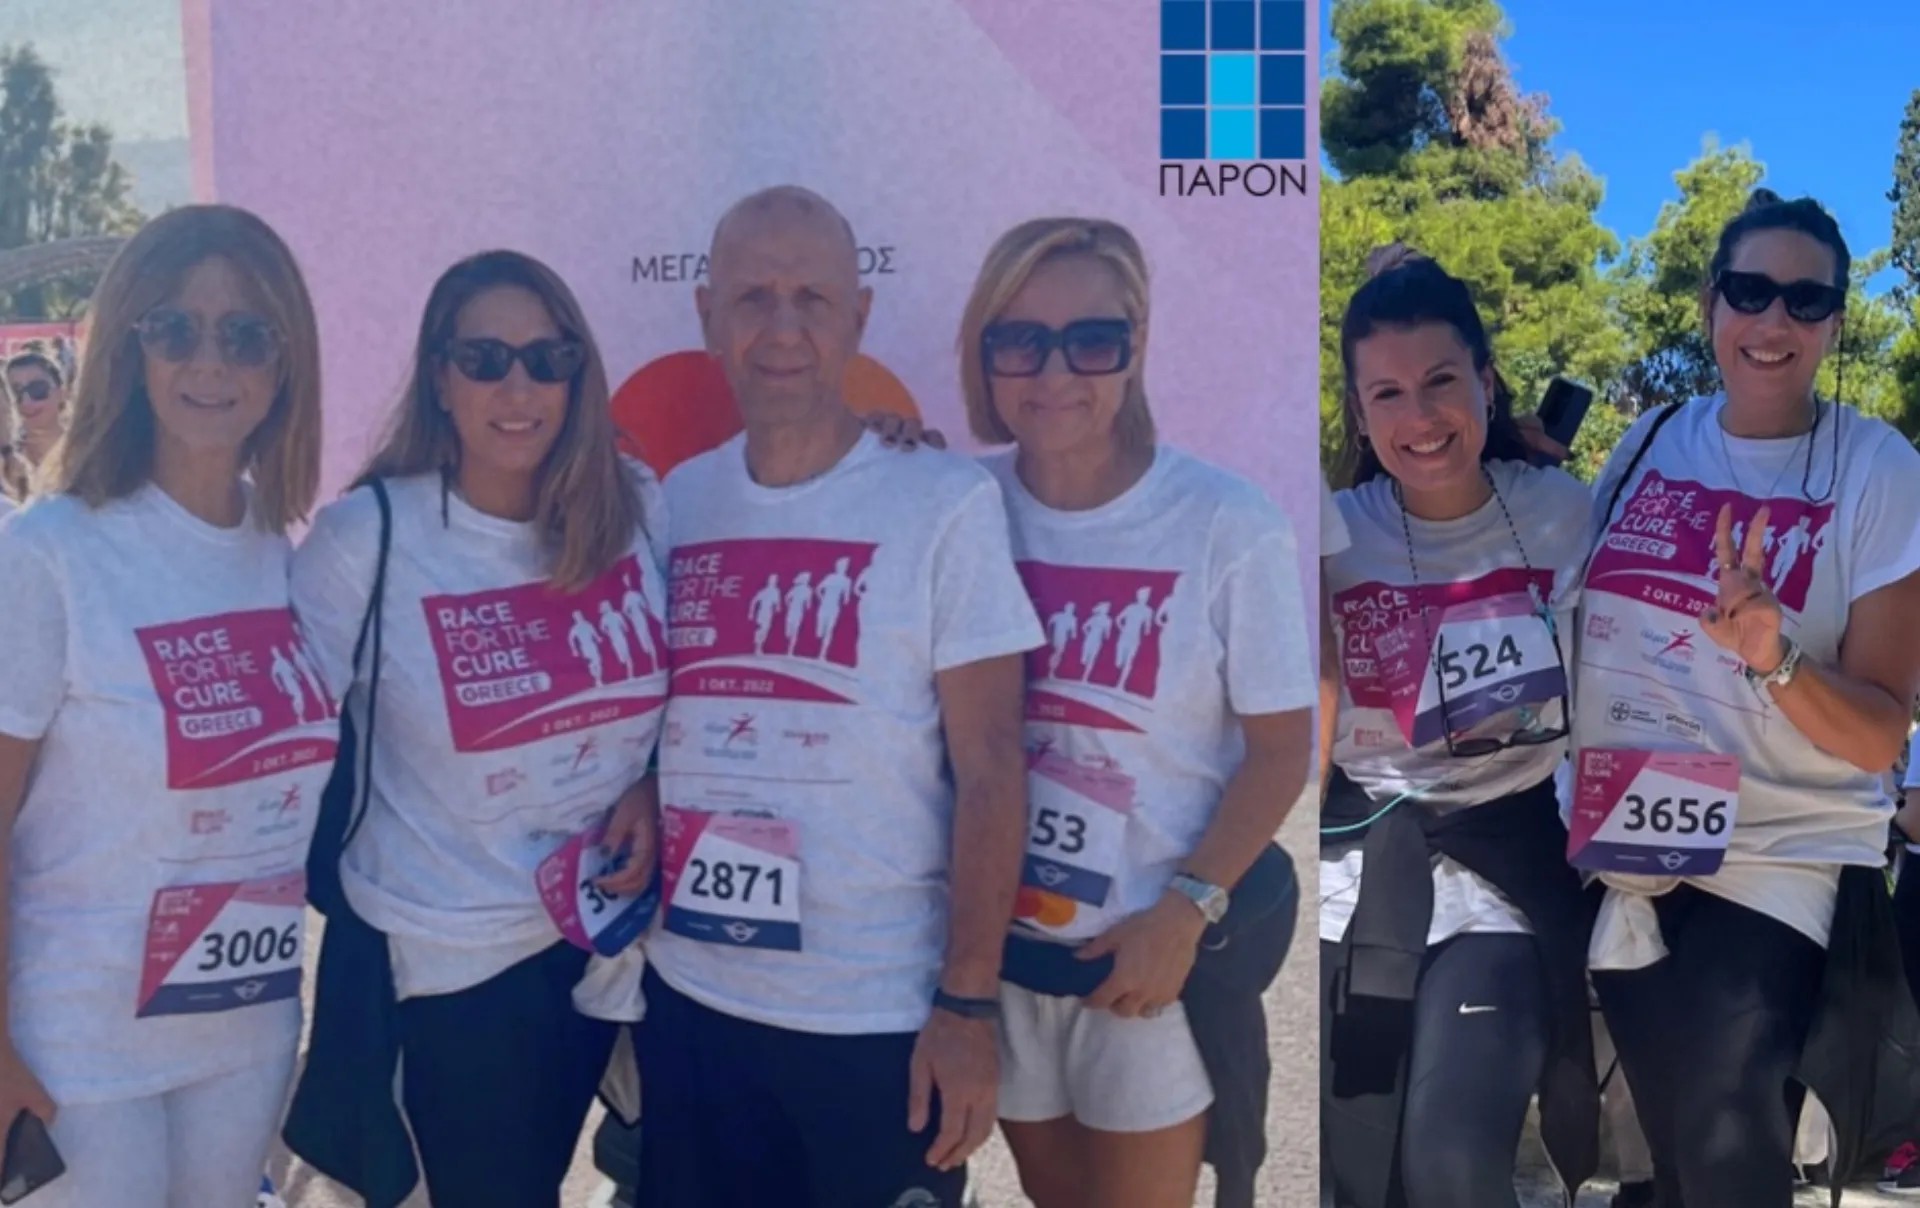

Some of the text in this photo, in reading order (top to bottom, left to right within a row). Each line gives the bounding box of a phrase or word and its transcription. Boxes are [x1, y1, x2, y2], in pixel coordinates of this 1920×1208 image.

[1630, 497, 1669, 517] FOR
[1642, 480, 1698, 510] RACE
[1609, 535, 1668, 558] GREECE
[1343, 590, 1410, 614] RACE
[1642, 585, 1652, 597] 2
[437, 600, 516, 630] RACE
[152, 627, 233, 661] RACE
[444, 618, 552, 654] FOR THE
[165, 651, 260, 687] FOR THE
[461, 675, 542, 702] GREECE
[184, 710, 252, 736] GREECE
[1623, 794, 1728, 836] 3656
[689, 857, 783, 906] 2871
[197, 921, 299, 972] 3006
